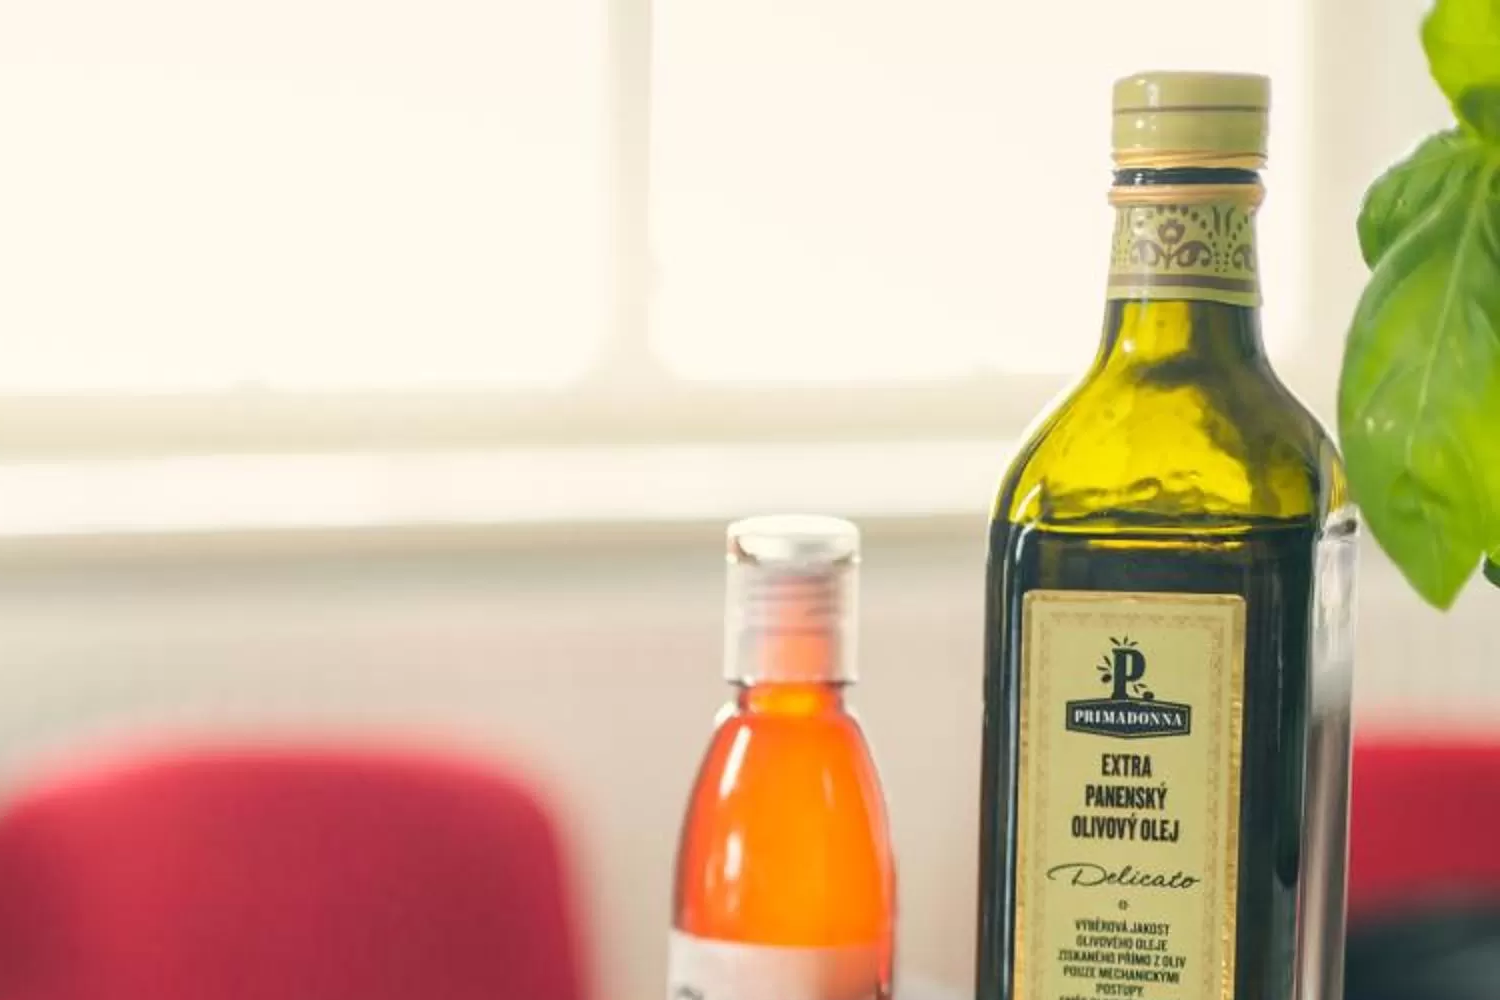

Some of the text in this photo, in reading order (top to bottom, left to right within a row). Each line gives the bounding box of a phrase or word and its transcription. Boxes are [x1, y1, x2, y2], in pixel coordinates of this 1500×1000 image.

[1074, 707, 1183, 727] PRIMADONNA
[1101, 753, 1152, 777] EXTRA
[1085, 782, 1168, 810] PANENSKÝ
[1071, 813, 1180, 842] OLIVOVÝ OLEJ
[1046, 862, 1201, 889] Delicato
[1130, 921, 1170, 936] JAKOST
[1162, 955, 1187, 969] OLIV
